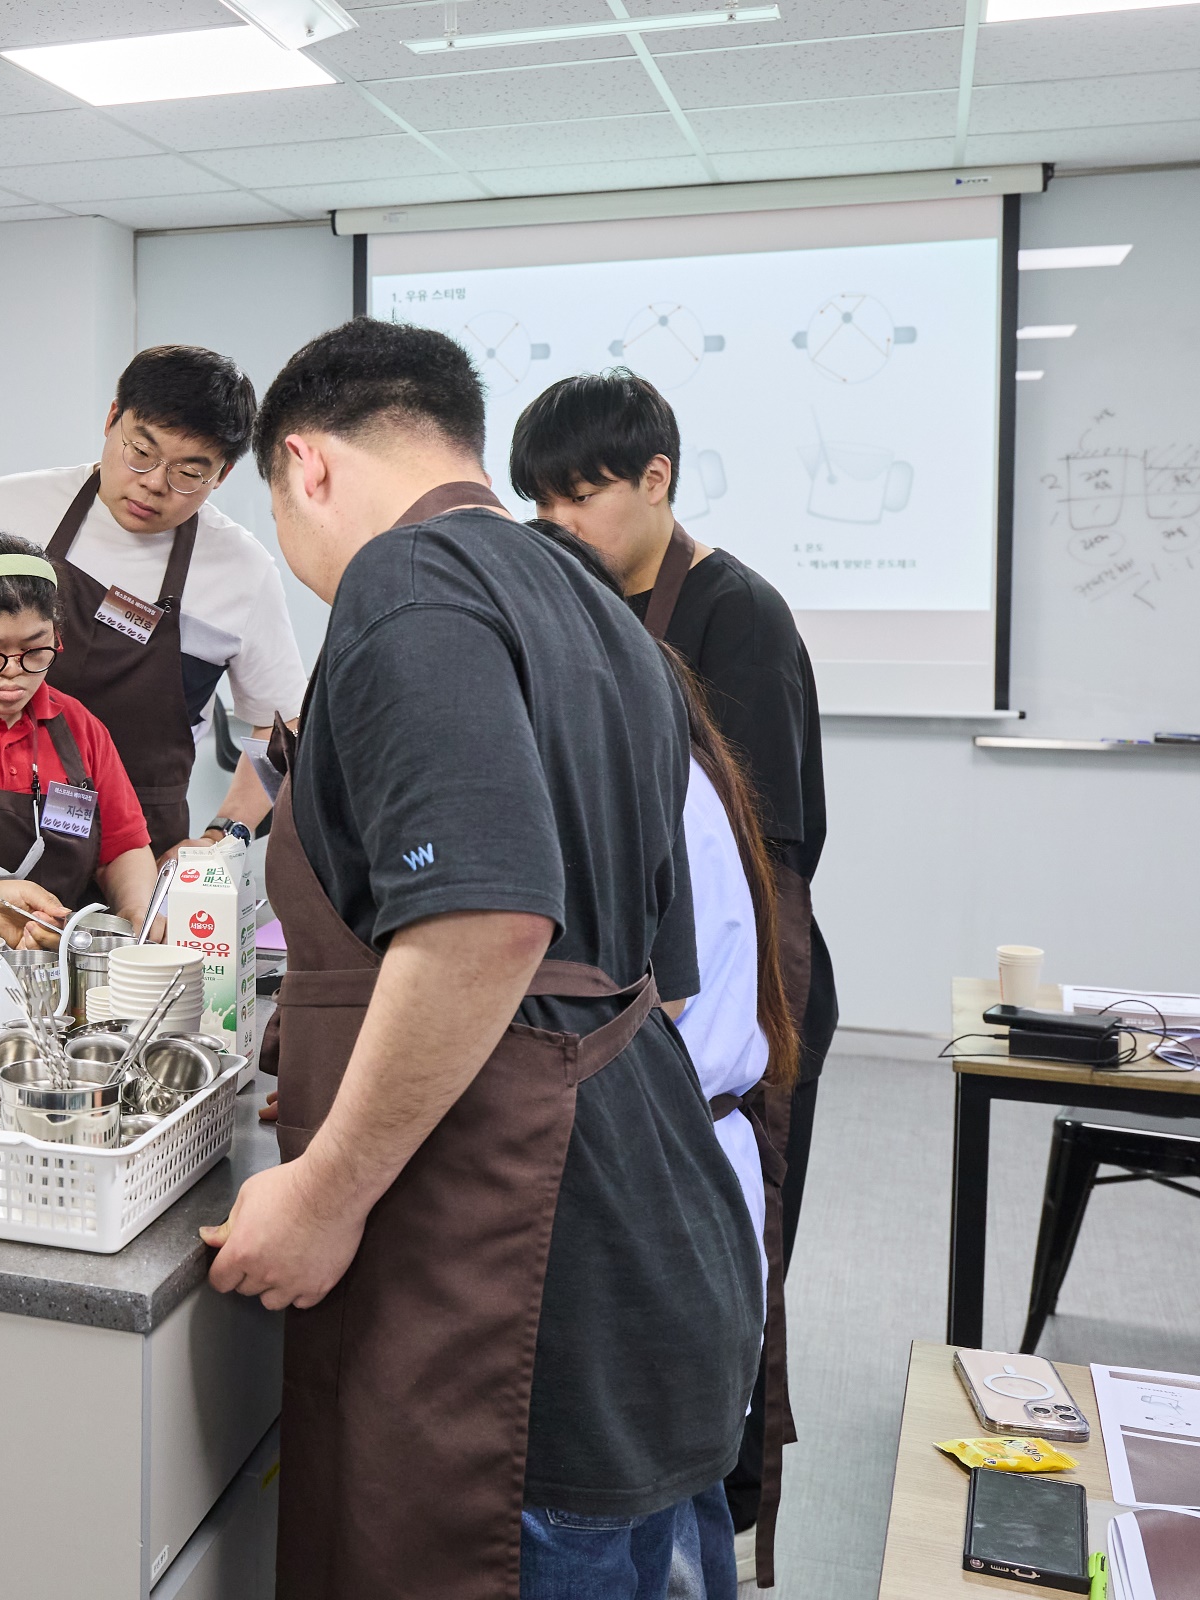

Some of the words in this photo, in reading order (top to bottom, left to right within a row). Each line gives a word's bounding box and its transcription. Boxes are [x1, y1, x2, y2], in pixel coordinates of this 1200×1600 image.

[406, 290, 428, 303] 우유
[432, 288, 466, 301] 스티밍
[124, 610, 153, 631] 이건호
[66, 805, 92, 821] 지수현
[206, 867, 224, 875] 밀크
[190, 922, 214, 931] 서울우유
